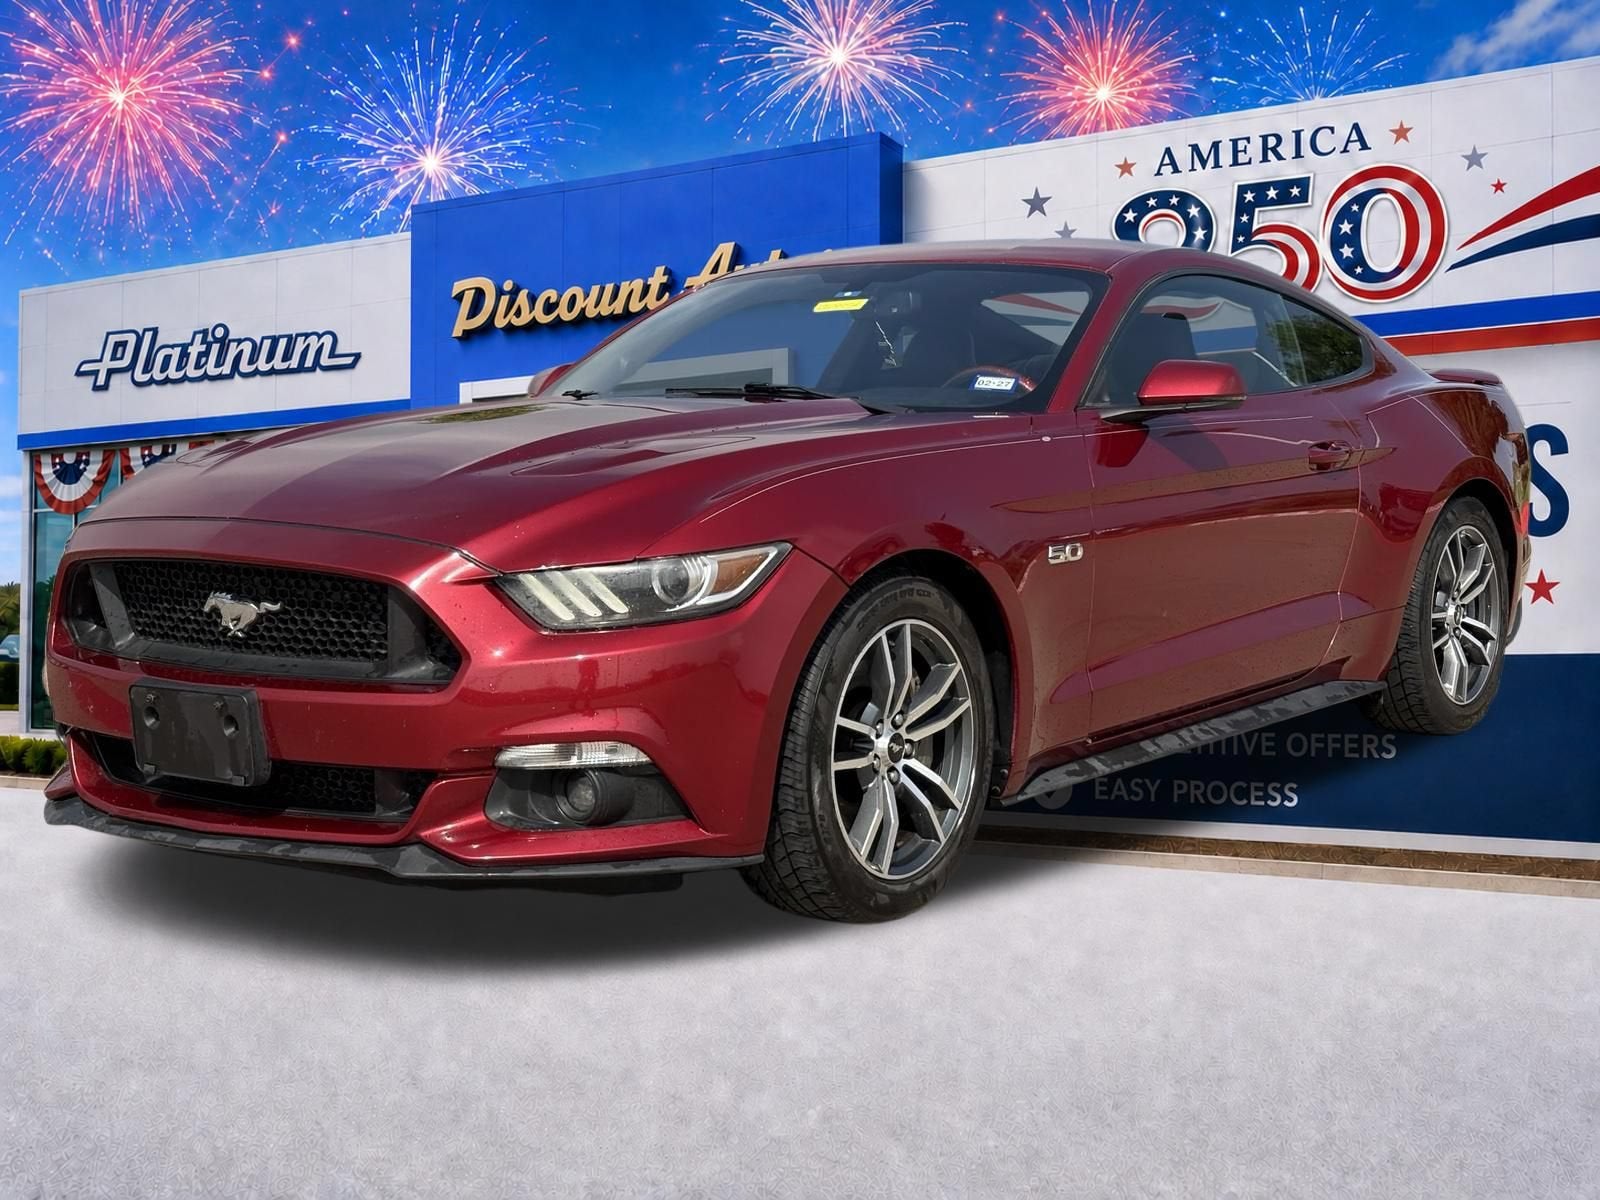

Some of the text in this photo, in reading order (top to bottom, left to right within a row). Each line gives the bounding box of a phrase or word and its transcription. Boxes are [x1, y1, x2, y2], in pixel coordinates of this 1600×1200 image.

[1154, 122, 1372, 176] AMERICA
[451, 264, 671, 338] Discount
[74, 323, 361, 391] Platinum
[1286, 733, 1397, 760] OFFERS
[1093, 777, 1299, 808] EASY PROCESS
